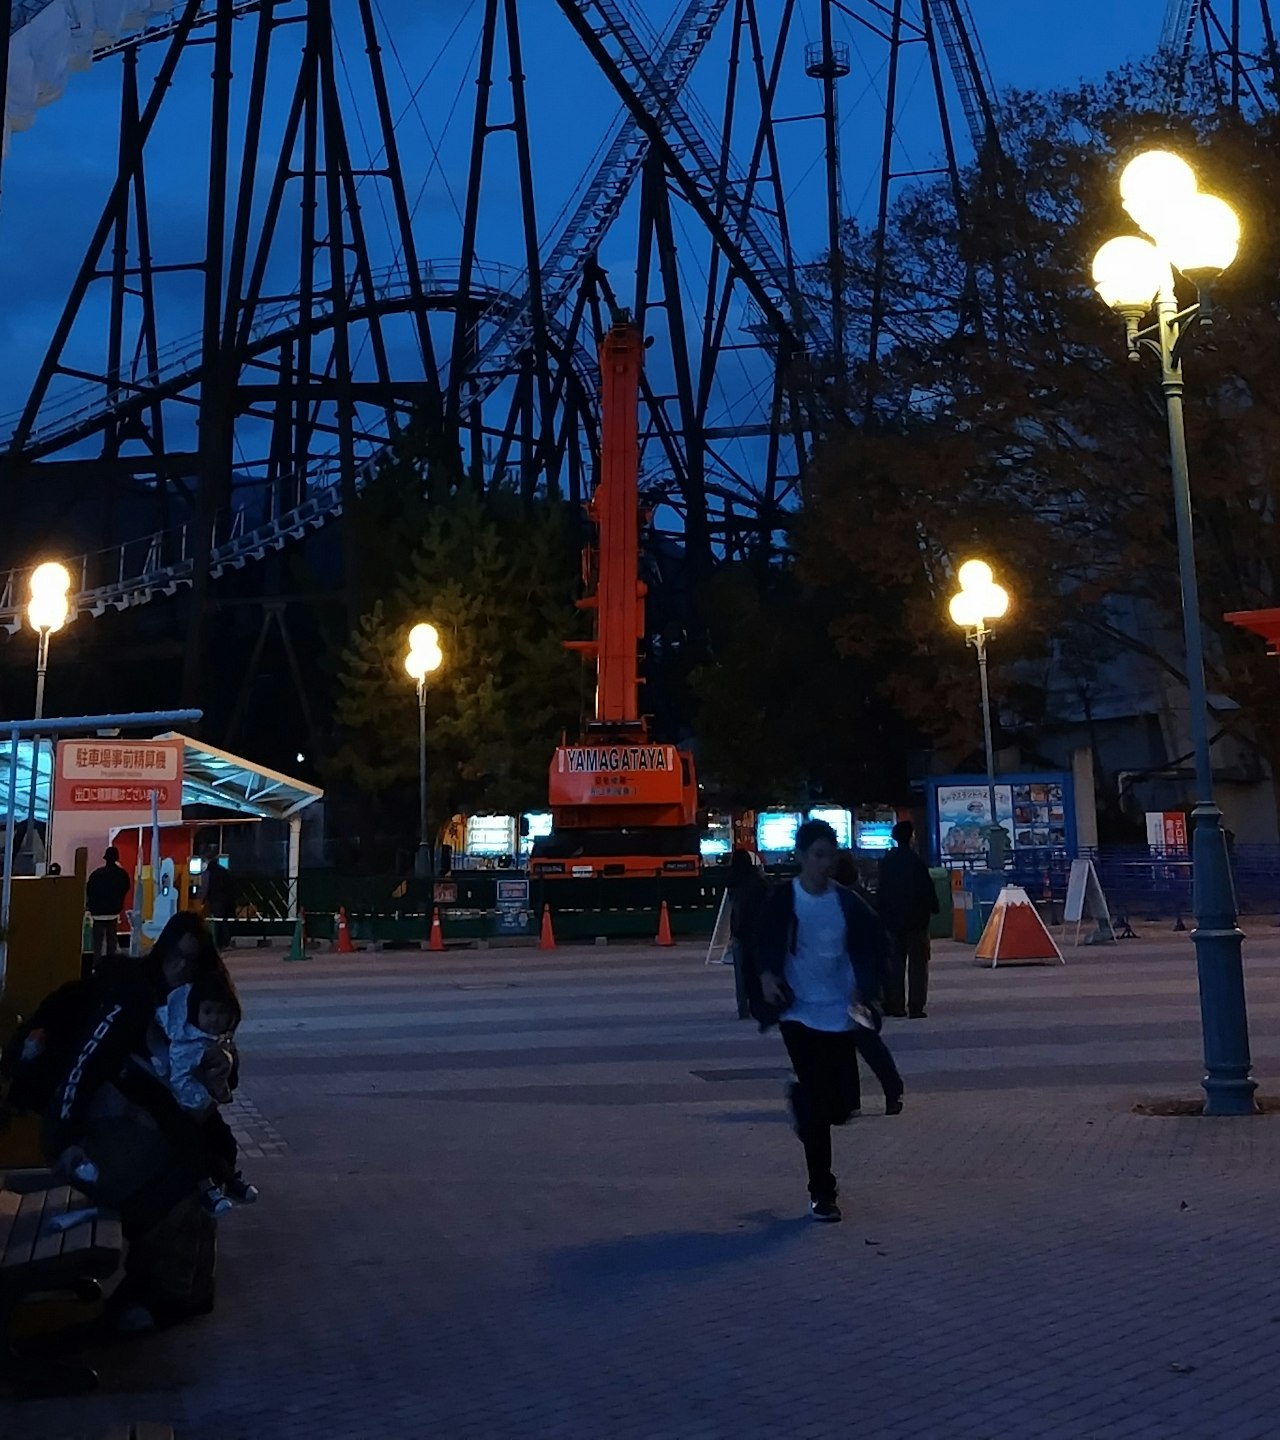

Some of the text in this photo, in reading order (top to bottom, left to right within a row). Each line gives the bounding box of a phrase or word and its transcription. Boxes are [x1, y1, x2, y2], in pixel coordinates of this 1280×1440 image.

[76, 748, 166, 769] 駐車場事前精算機
[567, 747, 666, 772] YAMAGATAYA
[74, 786, 167, 802] 出口にはございまん
